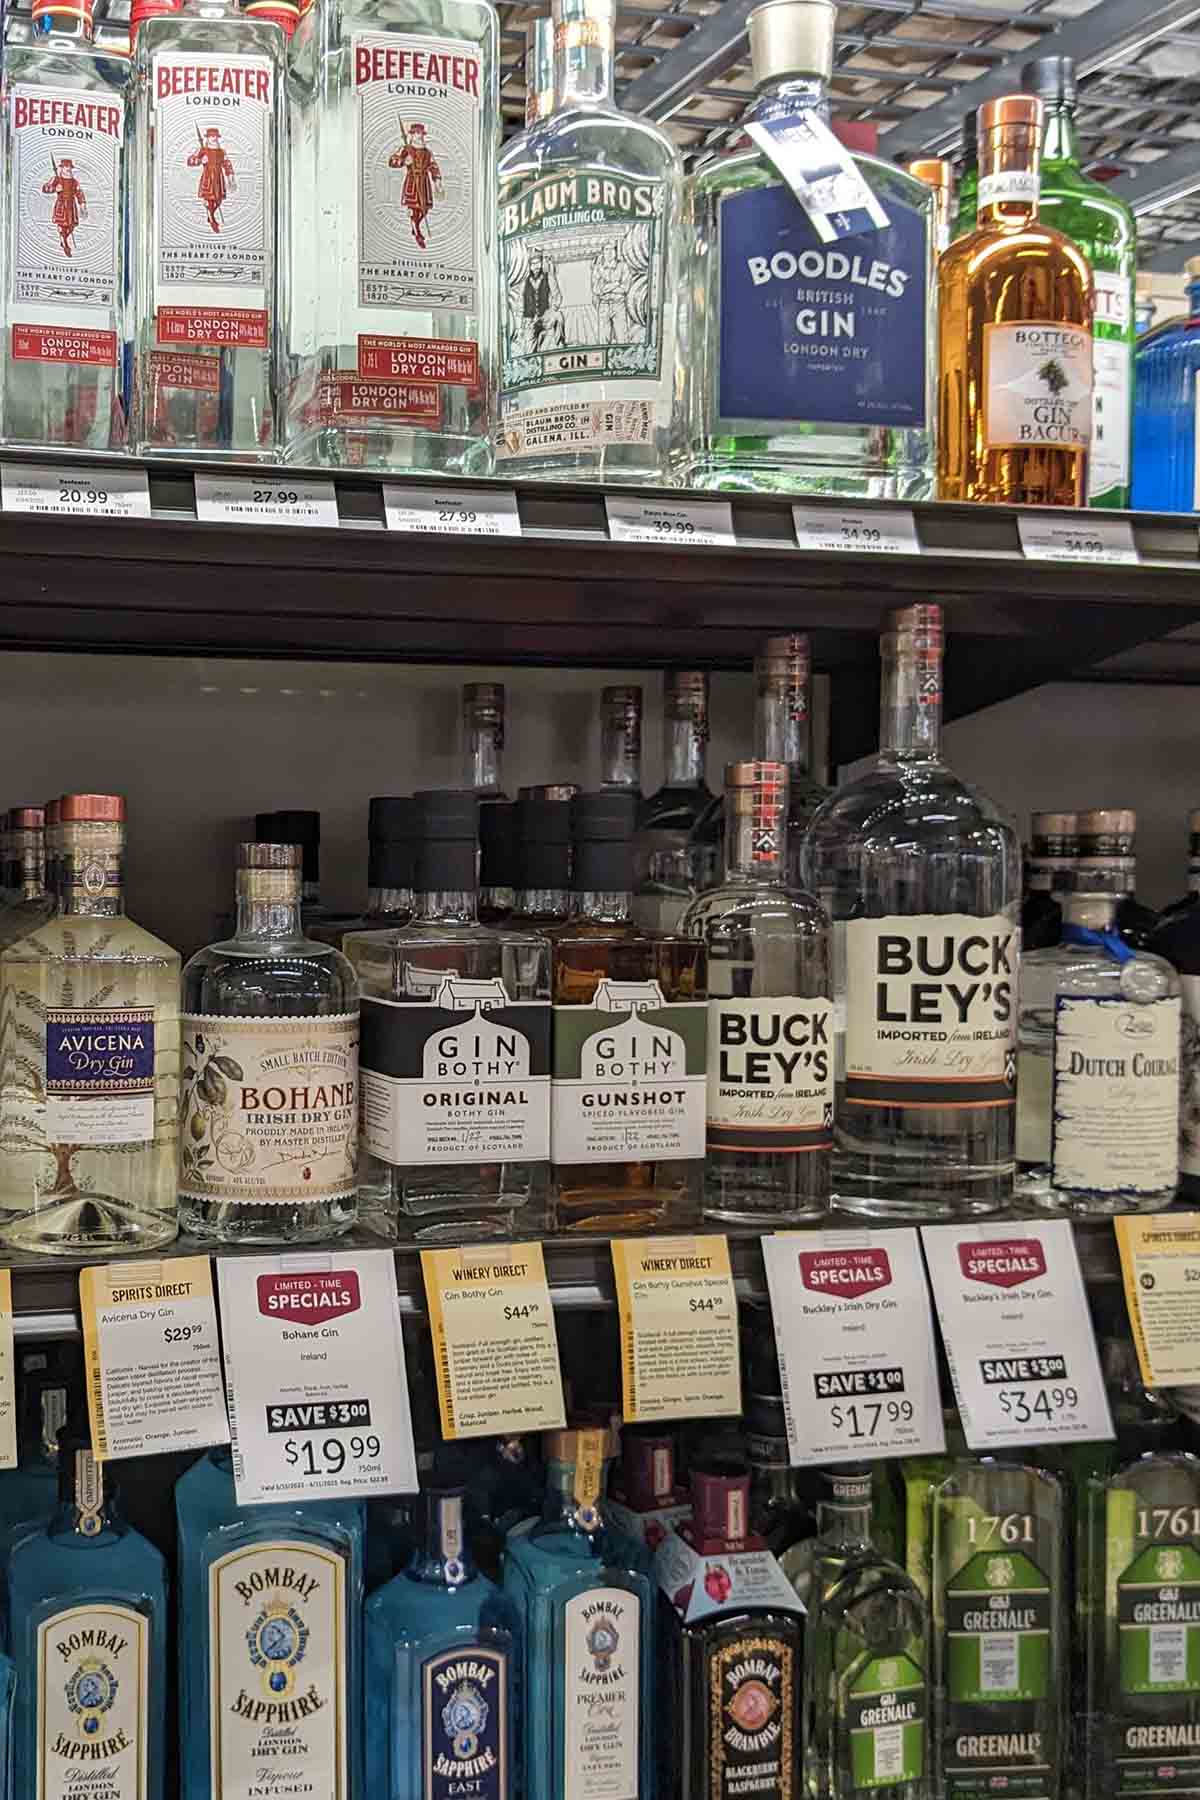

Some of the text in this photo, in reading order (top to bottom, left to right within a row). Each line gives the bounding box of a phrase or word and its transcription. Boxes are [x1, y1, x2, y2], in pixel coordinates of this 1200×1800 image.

[355, 47, 480, 98] BEEFEATER
[157, 66, 270, 104] BEEFEATER
[387, 82, 447, 98] LONDON
[186, 95, 241, 107] LONDON
[15, 97, 121, 139] BEEFEATER
[41, 127, 94, 140] LONDON
[505, 179, 577, 235] BLAUM
[542, 211, 591, 229] DISTILLING
[226, 254, 265, 262] LONDON
[36, 272, 61, 280] HEART
[79, 277, 114, 285] LONDON
[383, 269, 415, 278] HEART
[433, 273, 474, 282] LONDON
[748, 250, 909, 297] BOODLES
[797, 288, 854, 304] BRITISH
[188, 319, 239, 331] LONDON
[796, 308, 855, 338] GIN
[188, 329, 239, 340] DRY GIN
[41, 338, 89, 350] LONDON
[784, 343, 869, 360] LONDON DRY
[41, 347, 89, 358] DRY GIN
[391, 352, 446, 365] LONDON
[560, 354, 588, 369] GIN
[391, 364, 446, 376] DRY GIN
[352, 386, 408, 399] LONDON
[352, 397, 408, 409] DRY GIN
[605, 414, 613, 431] GIN
[1033, 405, 1072, 425] GIN
[59, 488, 108, 504] 20.99
[253, 490, 298, 505] 27.99
[439, 510, 477, 523] 27.99
[653, 520, 695, 534] 39.99
[877, 935, 1011, 976] BUCK
[876, 982, 1011, 1024] LEY'S
[720, 1012, 828, 1046] BUCK
[59, 1035, 145, 1051] AVICENA
[438, 1035, 516, 1058] GIN
[596, 1036, 672, 1059] GIN
[68, 1051, 133, 1076] Dry Gin
[260, 1057, 290, 1073] SMALL
[293, 1051, 320, 1063] BATCH
[438, 1061, 516, 1076] BOTHY
[596, 1061, 671, 1076] BOTHY
[720, 1050, 828, 1084] LEY'S
[423, 1090, 529, 1106] ORIGINAL
[582, 1091, 686, 1107] GUNSHOT
[246, 1111, 297, 1125] IRISH
[302, 1110, 331, 1124] DRY
[447, 1108, 505, 1117] BOTHY GIN
[582, 1110, 615, 1118] SPICED
[586, 1144, 624, 1152] PRODUCT
[641, 1256, 712, 1272] WINERY DIRECT
[814, 1256, 873, 1267] LIMITED TIME
[968, 1257, 1039, 1275] SPECIALS
[452, 1264, 526, 1281] WINERY DIRECT
[810, 1267, 884, 1285] SPECIALS
[112, 1282, 191, 1303] SPIRITS DIRECT
[274, 1279, 342, 1290] LIMITED TIME
[268, 1291, 352, 1310] SPECIALS
[444, 1288, 503, 1300] Gin Bothy Gin
[963, 1289, 1052, 1303] Buckley's Irish Dry Gin
[803, 1300, 897, 1314] Buckley's Irish Dry Gin
[101, 1308, 175, 1324] Avicena Dry Gin
[282, 1328, 339, 1340] Bohane Gin
[300, 1351, 327, 1361] Ireland
[983, 1361, 1029, 1381] SAVE
[818, 1375, 867, 1395] SAVE
[271, 1405, 326, 1427] SAVE
[967, 1513, 1035, 1544] 1761
[1136, 1506, 1200, 1538] 1761
[234, 1567, 320, 1606] BOMBAY
[581, 1600, 624, 1623] BOMBAY
[56, 1629, 129, 1663] BOMBAY
[435, 1661, 496, 1694] BOMBAY
[578, 1664, 627, 1686] SAPPHIRE
[726, 1659, 780, 1689] BOMBAY
[230, 1683, 325, 1724] SAPPHIRE
[51, 1728, 131, 1760] SAPPHIRE
[258, 1738, 302, 1747] LONDON
[724, 1721, 782, 1751] BRAMBLE
[251, 1744, 309, 1758] DRY GIN
[432, 1745, 497, 1778] SAPPHIRE
[64, 1765, 121, 1784] Distilled
[68, 1782, 115, 1793] LONDON
[248, 1784, 314, 1797] INFUSED
[448, 1780, 481, 1796] EAST
